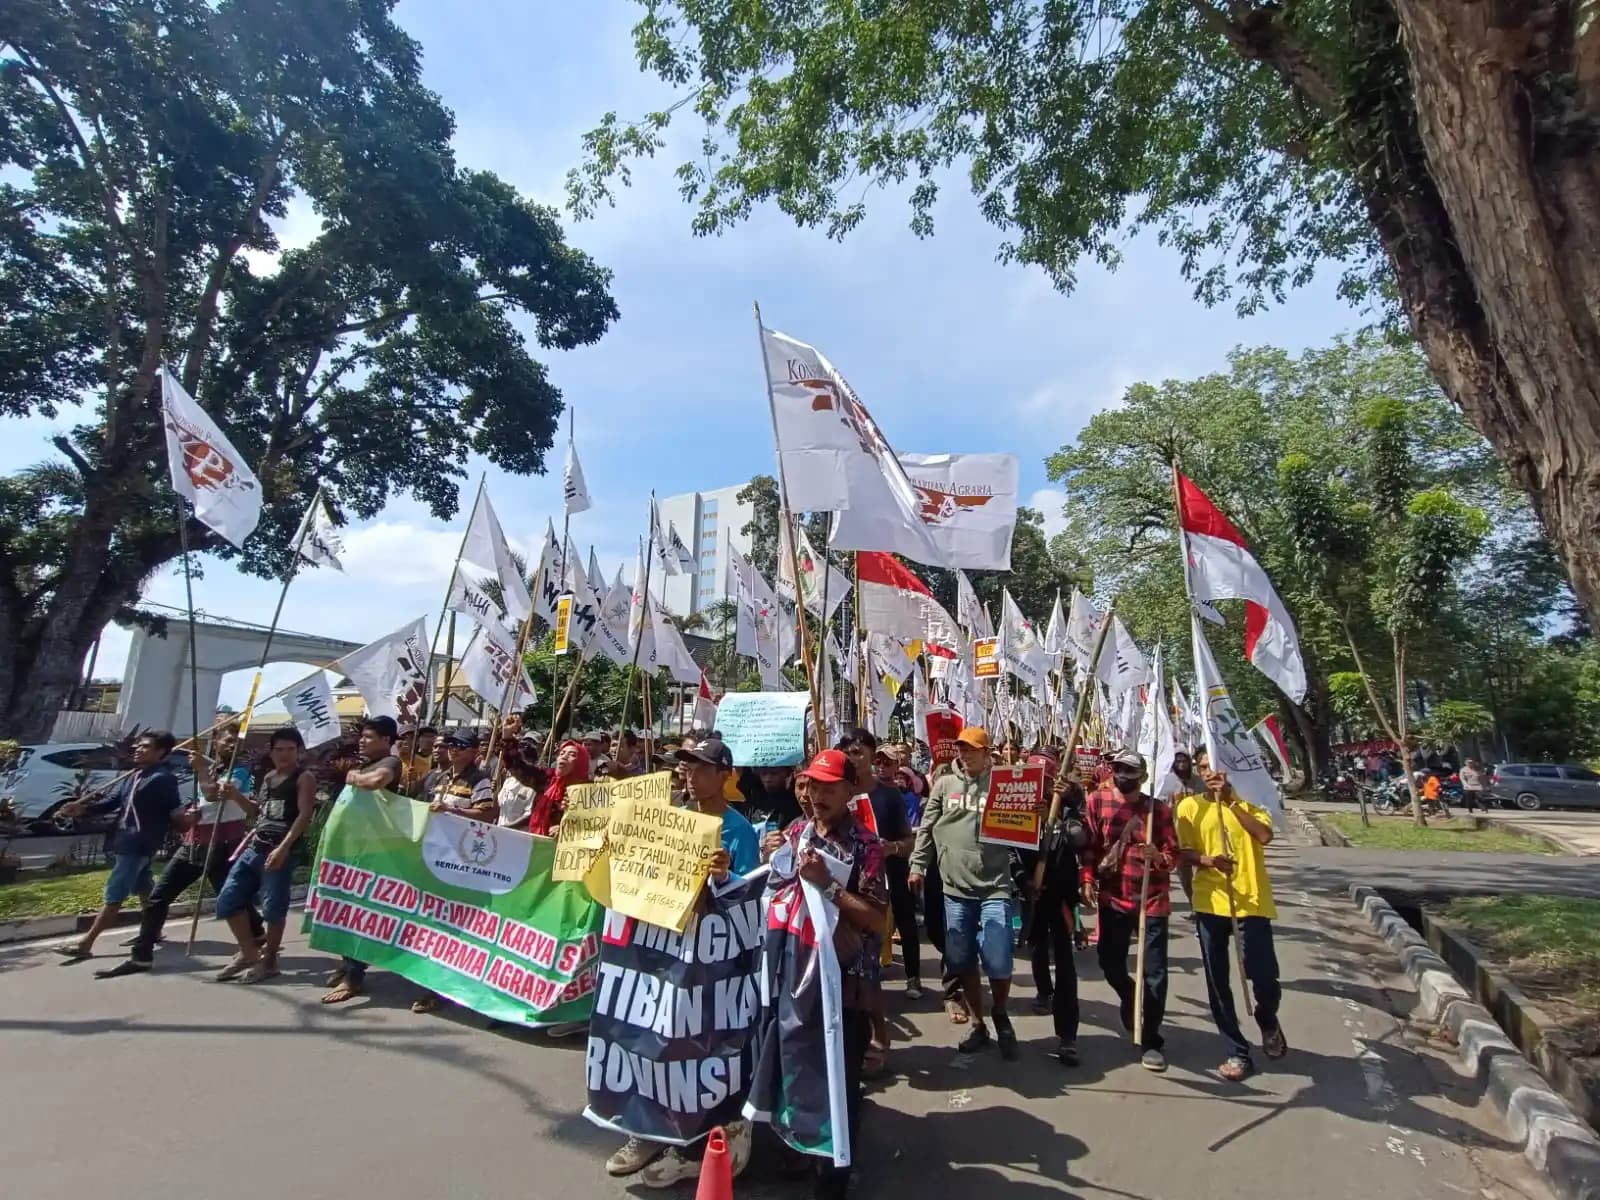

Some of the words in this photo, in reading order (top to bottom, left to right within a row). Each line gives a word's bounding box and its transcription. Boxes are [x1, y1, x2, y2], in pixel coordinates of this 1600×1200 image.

[949, 481, 993, 496] AGRARIA
[995, 793, 1037, 803] UNTUK
[997, 781, 1037, 793] TANAH
[634, 805, 697, 835] HAPUSKAN
[435, 860, 470, 873] SERIKAT
[471, 867, 491, 877] TANI
[493, 872, 512, 883] TEBO
[639, 846, 676, 871] TAHUN
[611, 858, 660, 880] TENTANG
[665, 872, 691, 893] PKH
[371, 878, 419, 910] IZIN
[500, 920, 556, 967] KARYA
[399, 922, 488, 977] REFORMA
[596, 962, 702, 1039] TIBAN
